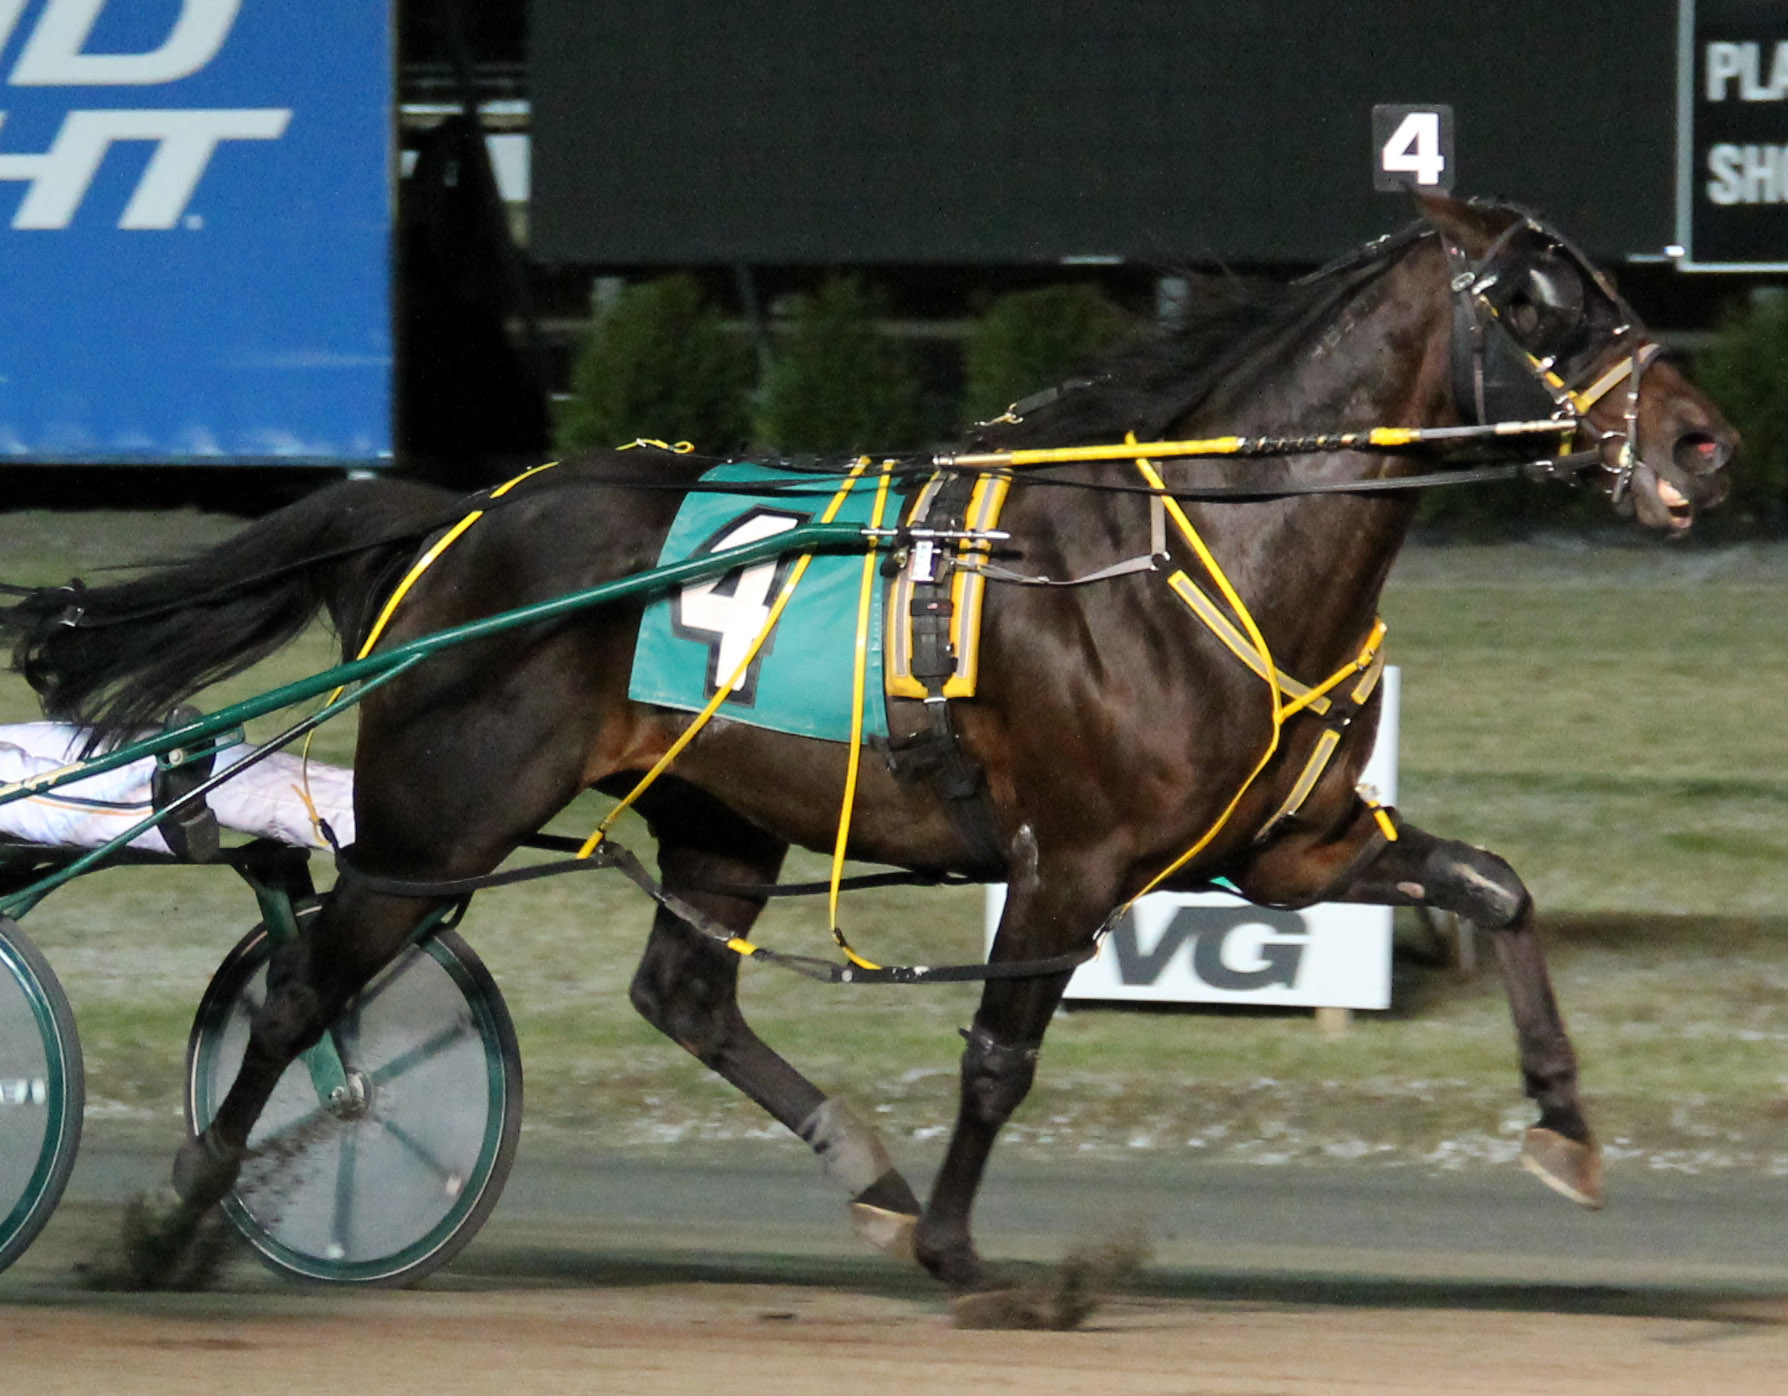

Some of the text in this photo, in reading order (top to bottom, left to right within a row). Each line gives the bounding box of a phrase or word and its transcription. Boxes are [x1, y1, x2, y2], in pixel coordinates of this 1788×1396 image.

[0, 0, 242, 86] D
[1382, 112, 1445, 185] 4
[1706, 143, 1788, 205] SH
[676, 508, 806, 700] 4
